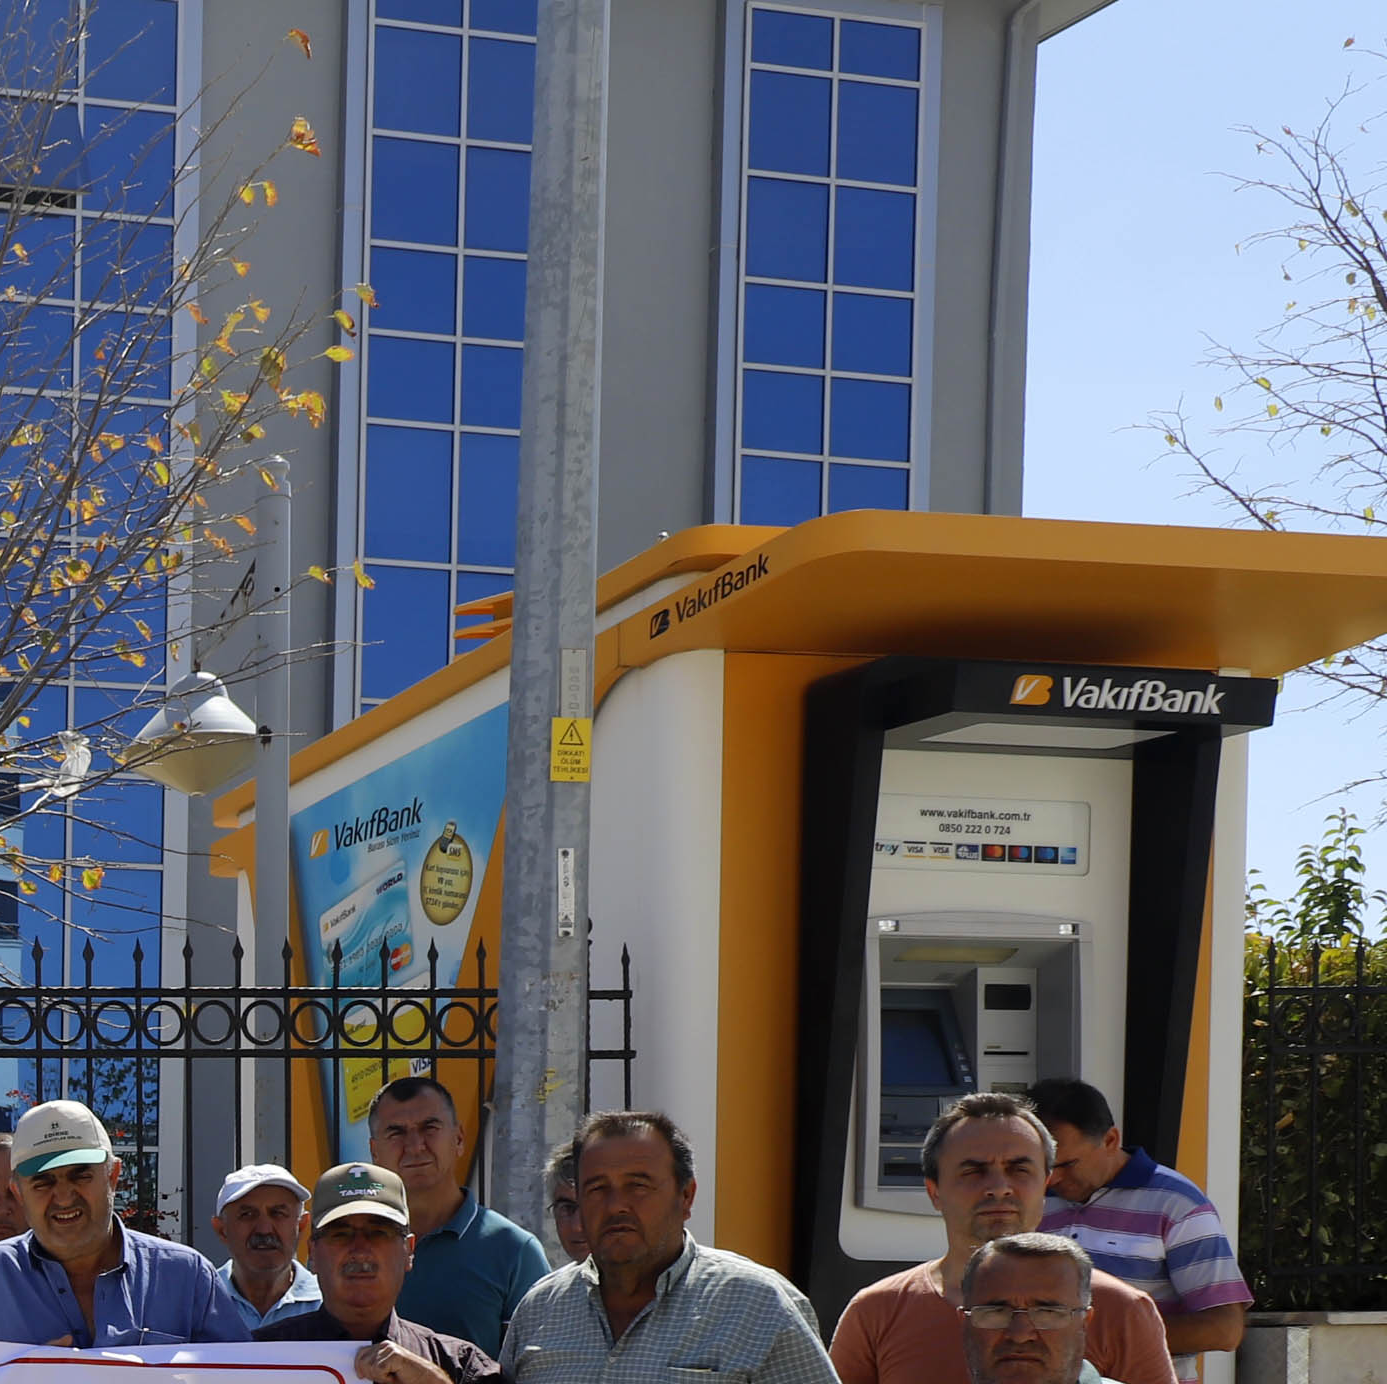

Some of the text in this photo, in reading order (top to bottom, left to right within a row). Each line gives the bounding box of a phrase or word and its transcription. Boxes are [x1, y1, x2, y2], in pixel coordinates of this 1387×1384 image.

[674, 553, 770, 624] VakıfBank
[1063, 676, 1226, 714] VakıfBank
[919, 808, 1031, 821] www.vakifbank.com.tr
[334, 796, 423, 851] VakıfBank
[938, 823, 1011, 835] 0850 222 0 724
[875, 841, 900, 855] troy
[906, 845, 924, 854] VISA
[933, 846, 950, 855] VISA
[339, 1188, 380, 1197] TARIM
